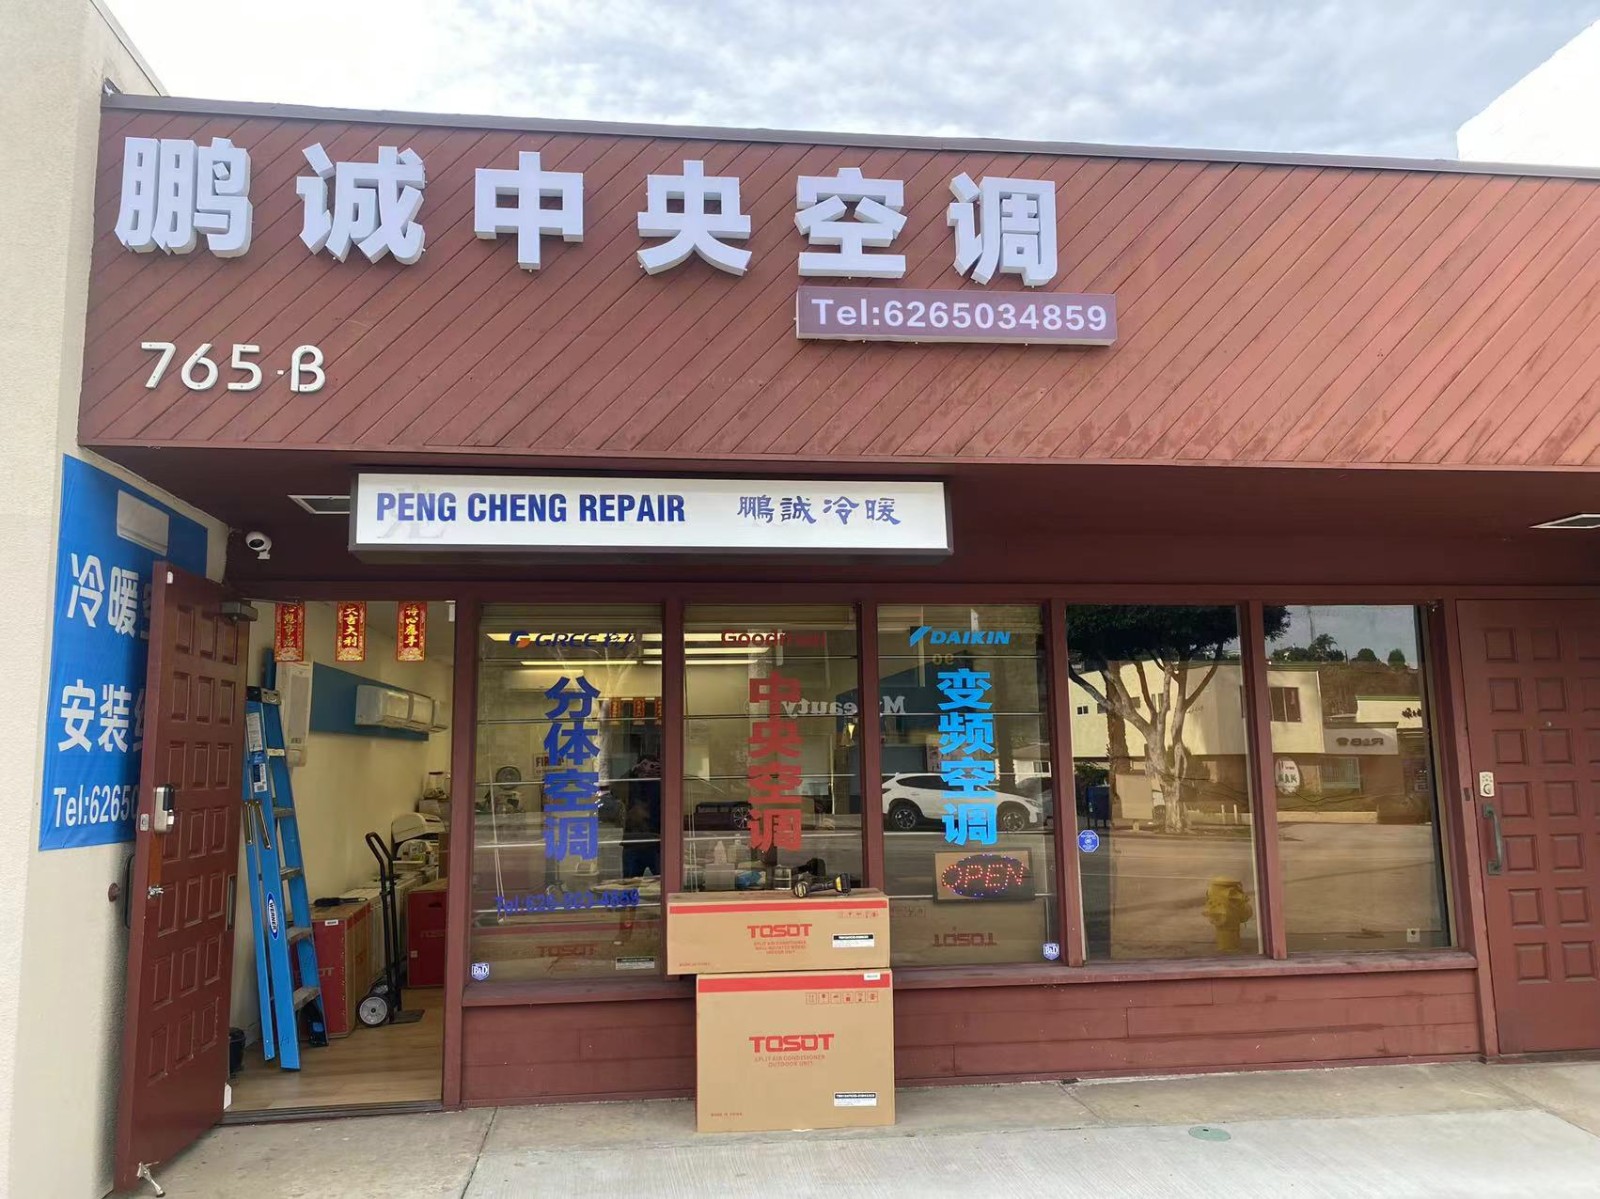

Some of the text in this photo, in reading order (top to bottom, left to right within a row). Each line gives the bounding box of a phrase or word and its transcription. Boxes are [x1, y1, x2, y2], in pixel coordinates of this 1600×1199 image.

[115, 136, 1058, 287] 鹏诚中央空调
[811, 298, 1108, 332] Tel:6265034859
[376, 493, 686, 523] PENG CHENG REPAIR
[737, 494, 902, 526] 鵬誠冷暖
[930, 630, 1011, 645] DAIKIN
[543, 675, 601, 862] 分体空调
[748, 672, 803, 852] 中央空调
[936, 668, 998, 847] 变频空调
[941, 863, 1025, 889] OPEN
[269, 902, 277, 931] WERNER
[747, 923, 812, 939] TOSOT
[749, 1033, 835, 1053] TOSOT
